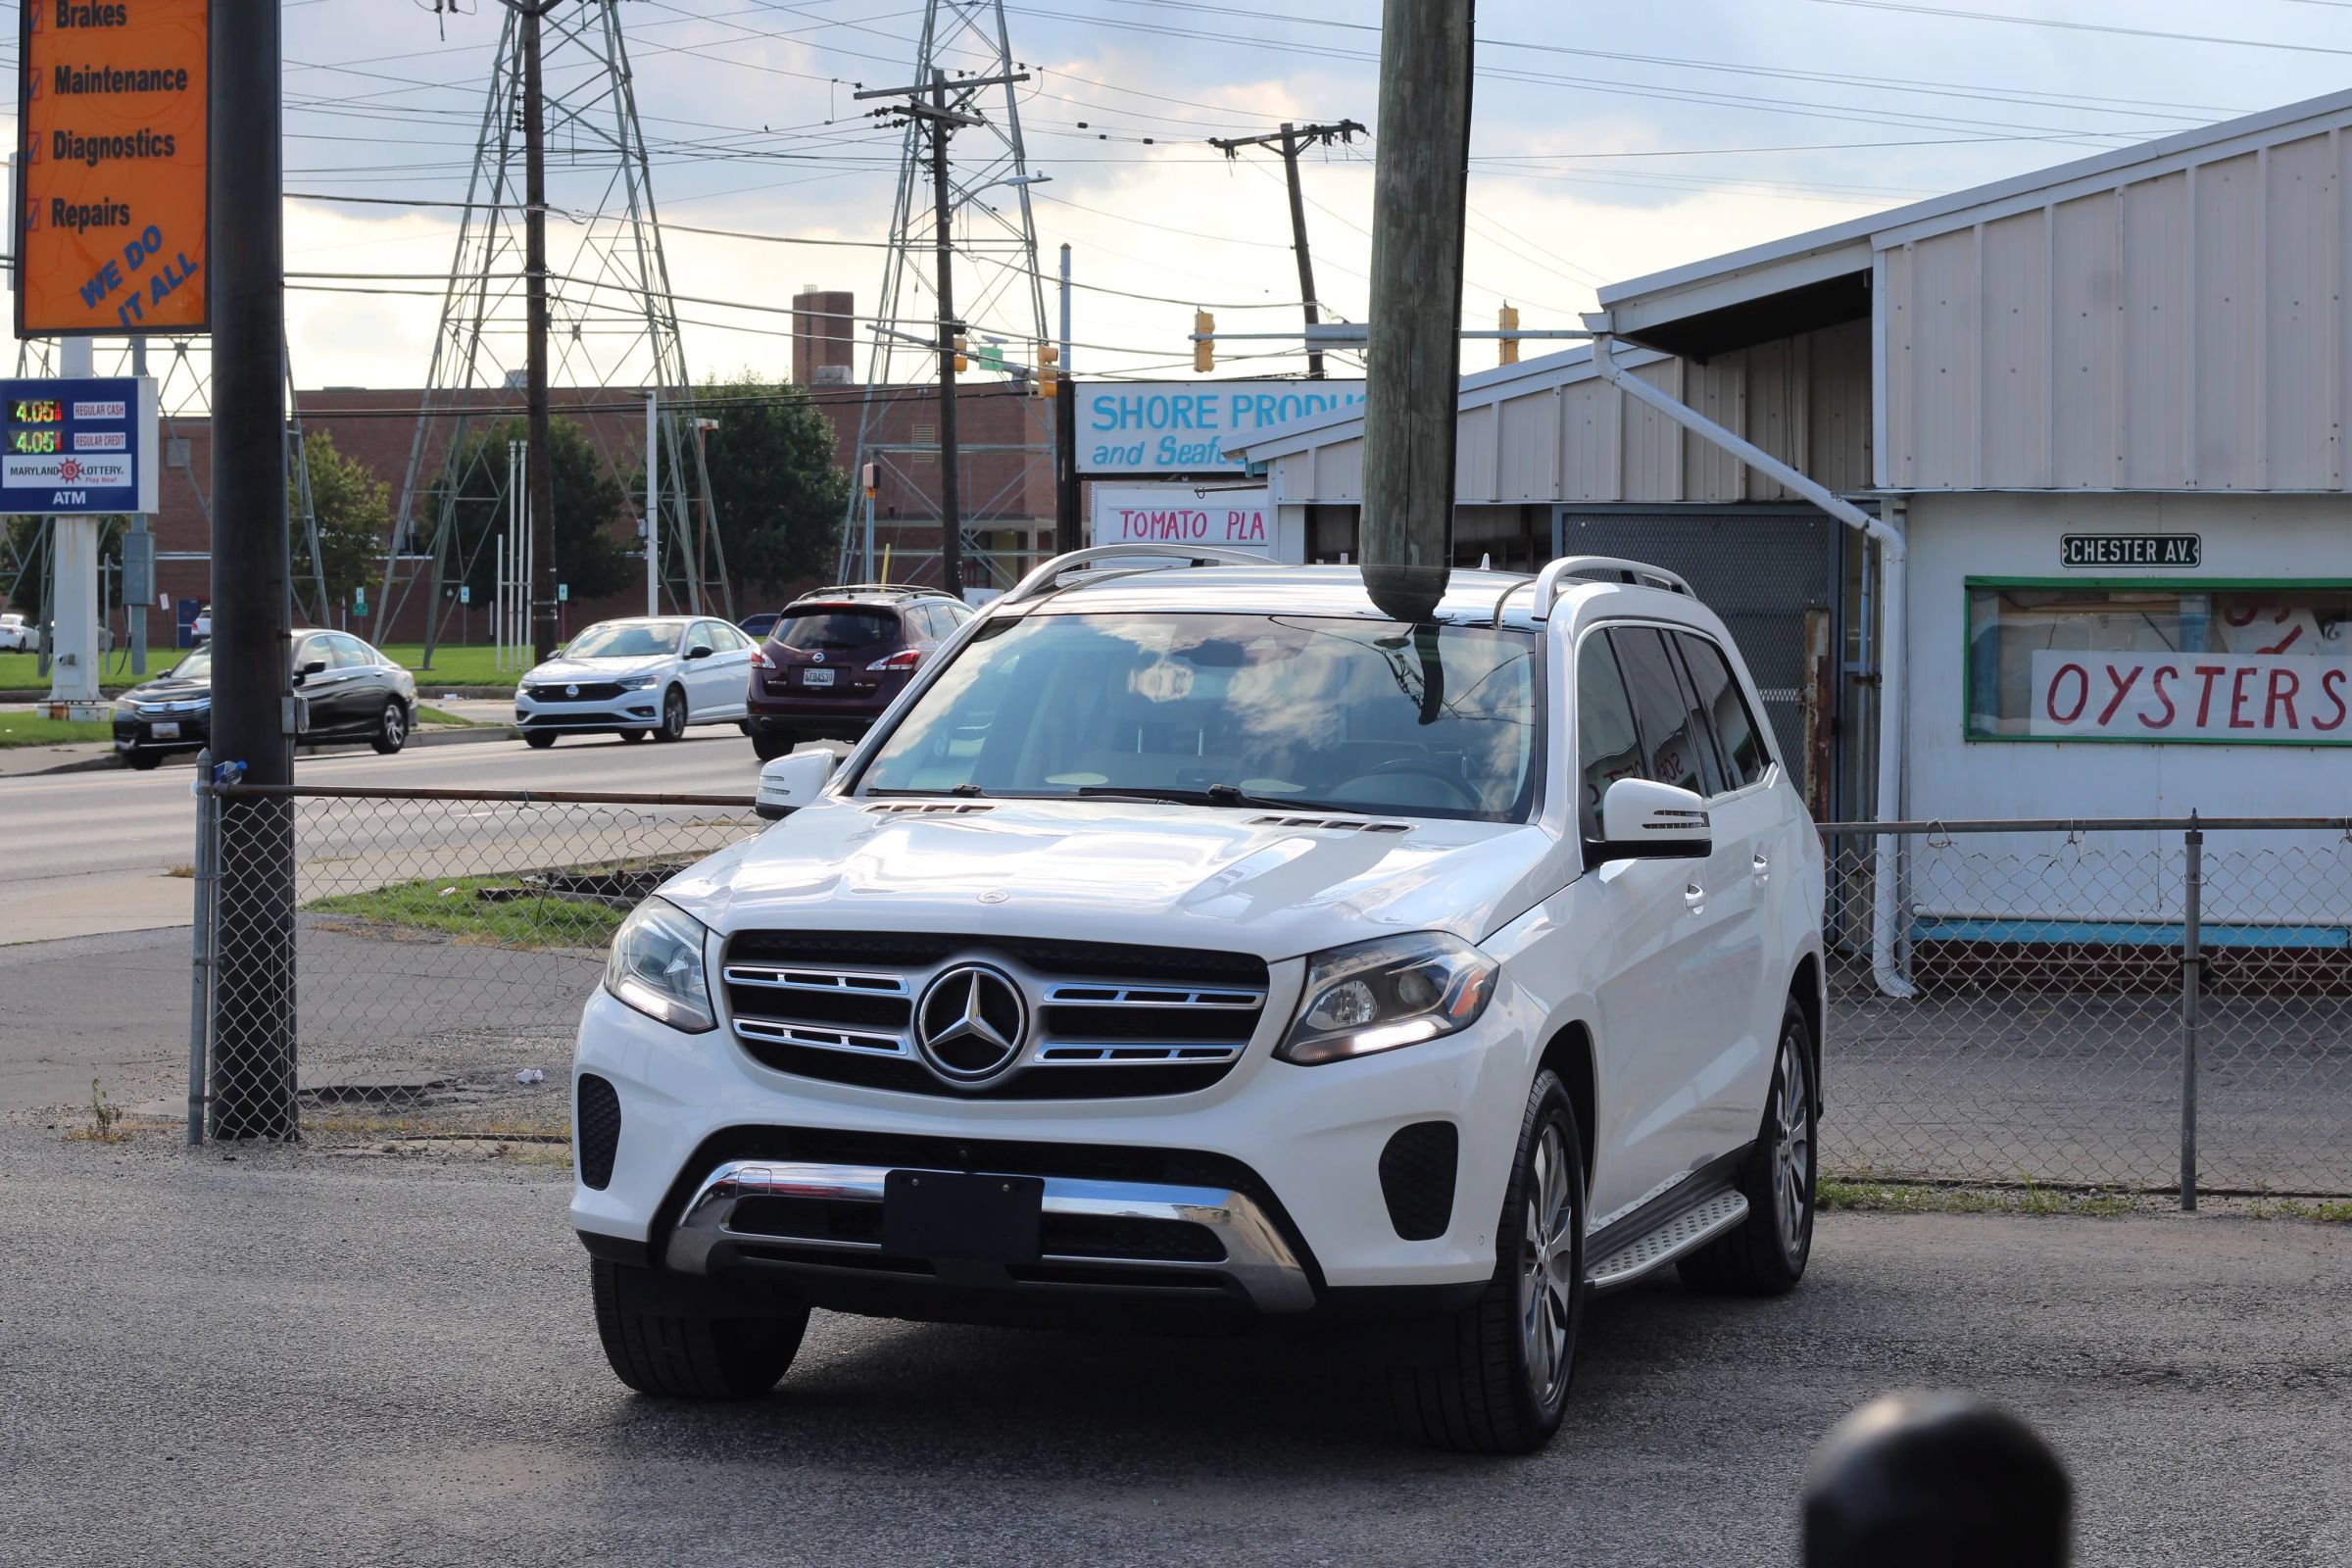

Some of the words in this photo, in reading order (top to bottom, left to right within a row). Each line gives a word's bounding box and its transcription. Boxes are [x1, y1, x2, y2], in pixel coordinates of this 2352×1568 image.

[56, 0, 126, 28] Brakes
[54, 65, 187, 95] Maintenance
[52, 128, 175, 167] Diagnostics
[51, 197, 130, 234] Repairs
[78, 260, 123, 309] WE
[123, 225, 163, 271] DO
[118, 292, 143, 327] IT
[149, 252, 198, 307] ALL
[74, 404, 105, 416] REGULAR
[107, 404, 124, 416] CASH
[1091, 394, 1218, 431] SHORE
[75, 436, 103, 447] REGULAR
[104, 435, 124, 447] CREDIT
[1093, 441, 1145, 466] and
[10, 466, 59, 475] MARYLAND
[81, 466, 122, 475] LOTTERY
[52, 491, 86, 505] ATM
[1119, 510, 1207, 540] TOMATO
[1226, 512, 1265, 540] PLA
[2070, 540, 2156, 562] CHESTER
[2164, 540, 2190, 562] AV.
[2046, 663, 2347, 731] OYSTERS
